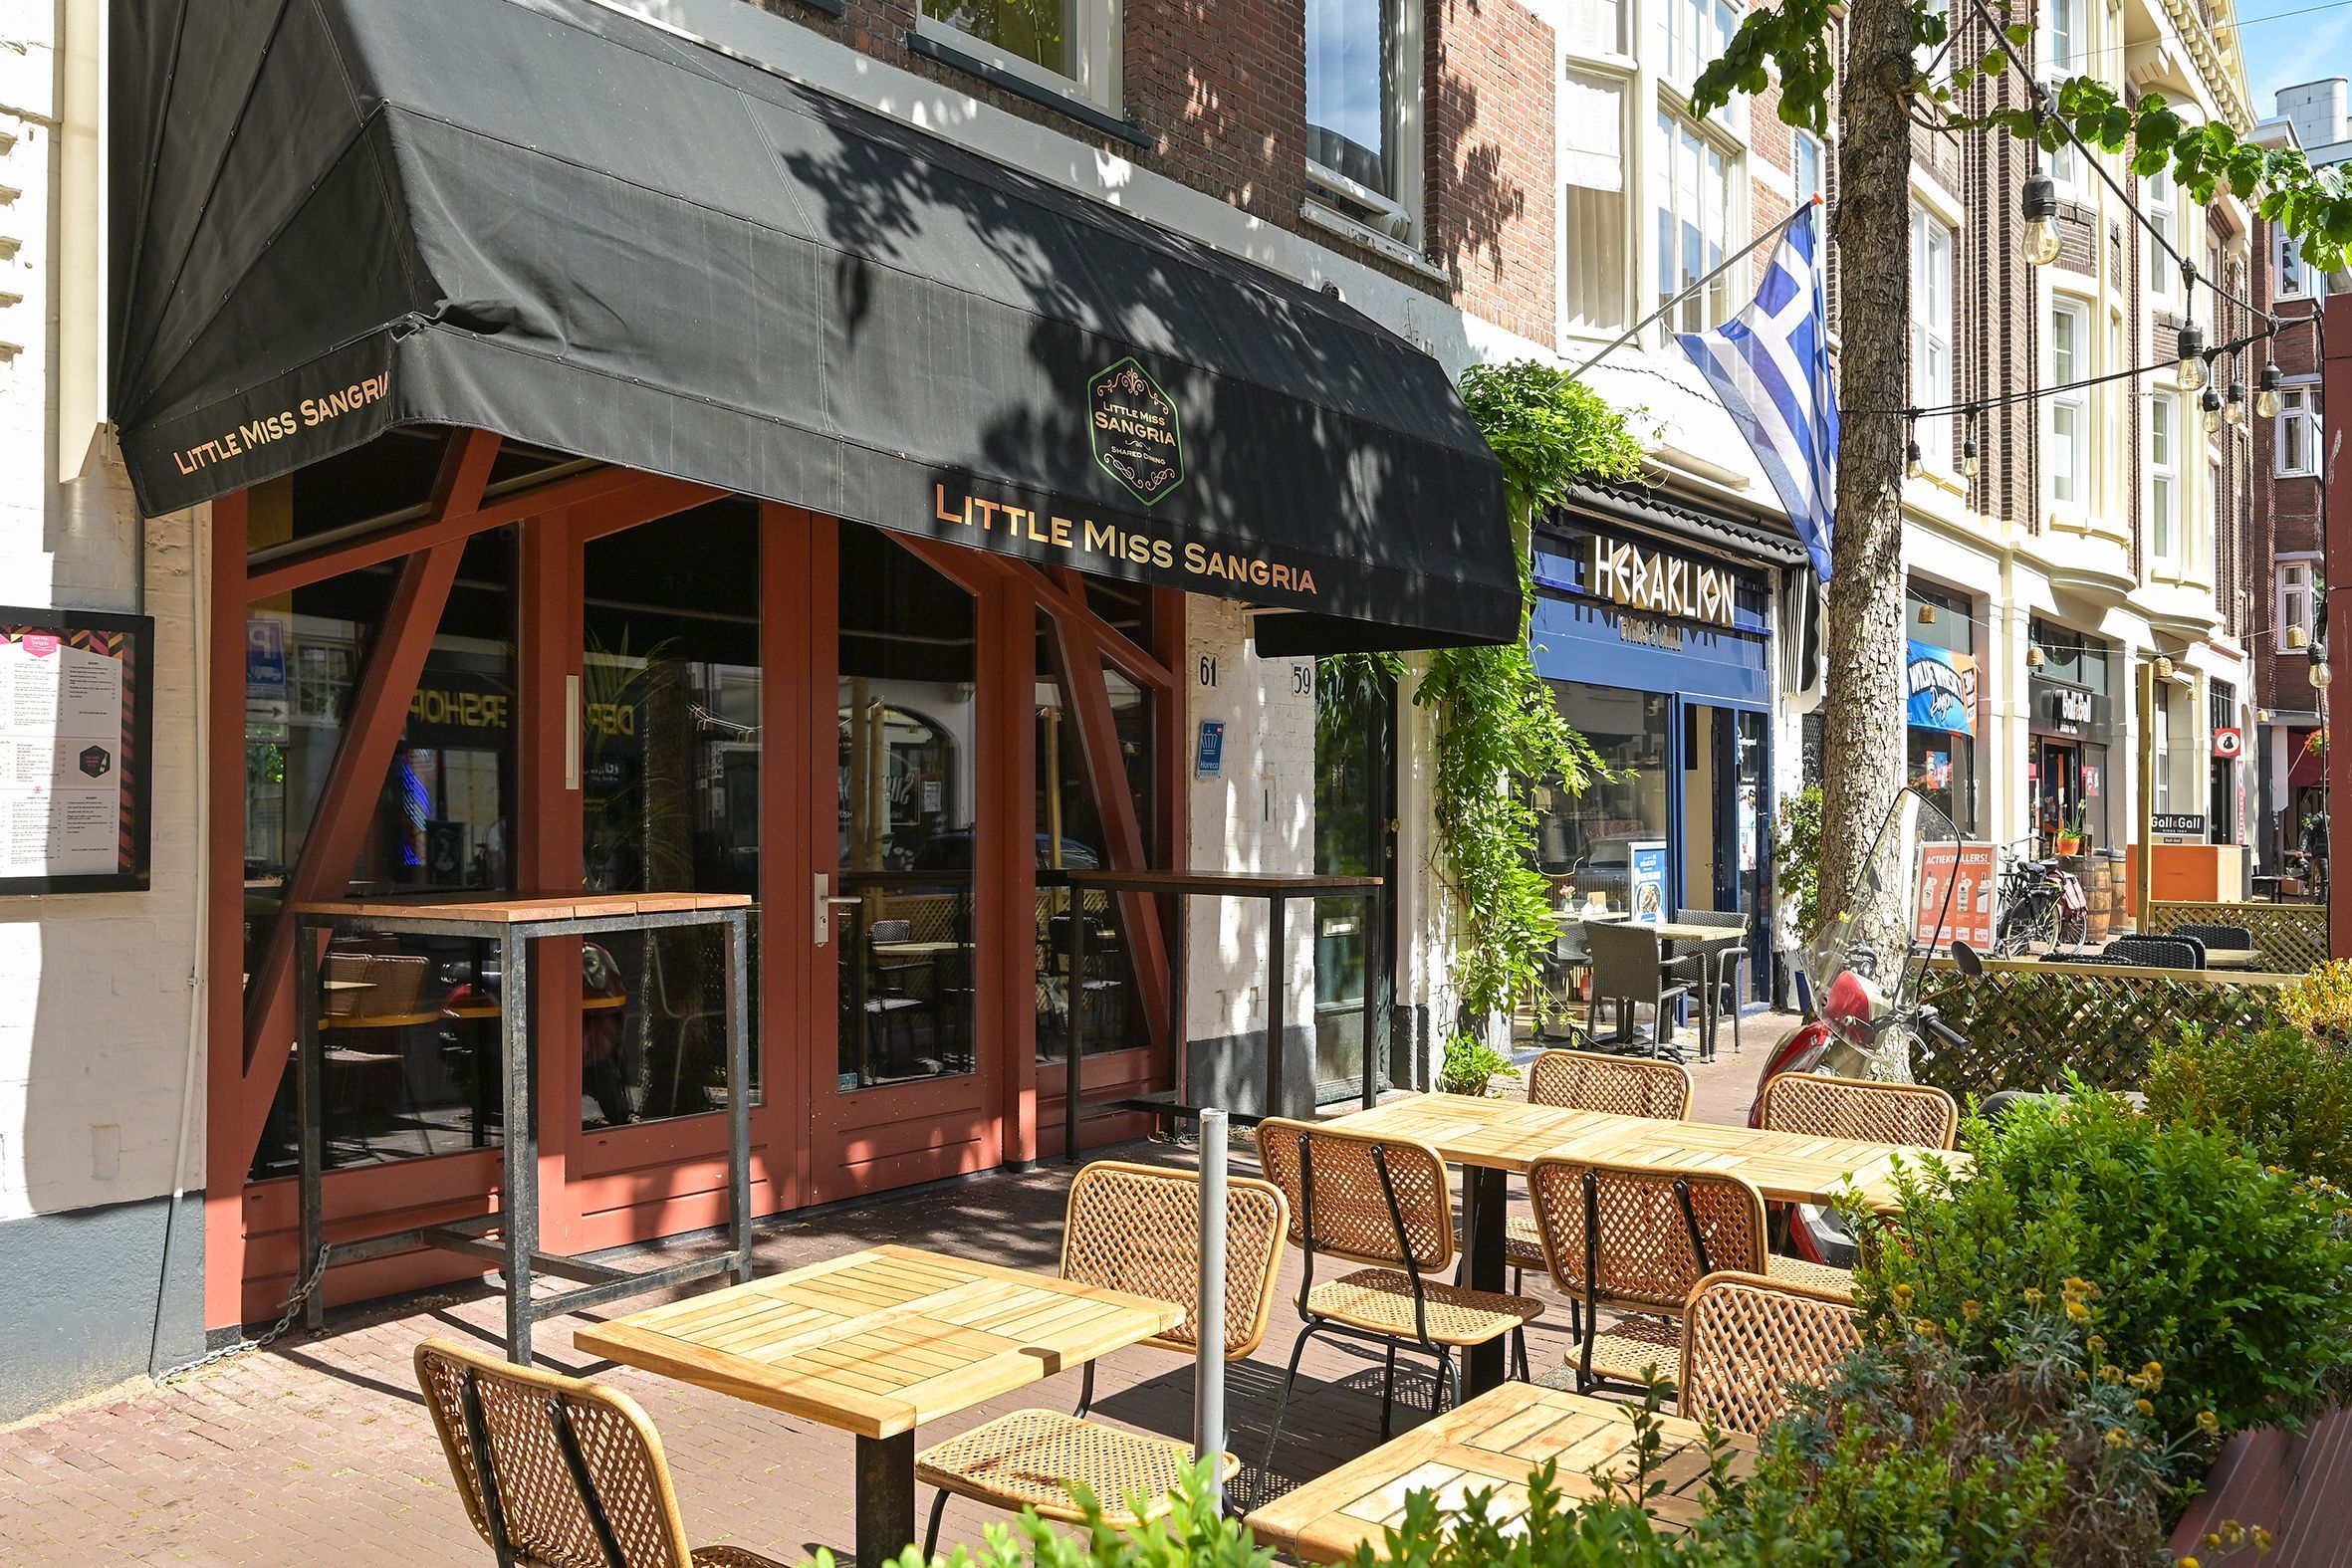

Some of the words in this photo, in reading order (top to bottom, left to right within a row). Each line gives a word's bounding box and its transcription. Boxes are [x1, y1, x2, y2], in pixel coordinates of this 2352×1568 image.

[1102, 400, 1139, 418] LITTLE
[1139, 410, 1166, 426] MISS
[173, 433, 242, 475] LITTLE
[239, 410, 298, 450] MISS
[1094, 410, 1177, 447] SANGRIA
[1110, 445, 1143, 459] SHARED
[1143, 452, 1166, 466] DINING
[935, 483, 1074, 550] LITTLE
[1083, 519, 1174, 570] MISS
[1183, 542, 1317, 595] SANGRIA
[1594, 534, 1736, 628] HERAKLION
[1200, 655, 1218, 687] 61
[1294, 666, 1311, 695] 59
[1199, 760, 1220, 770] Horeca
[1926, 853, 1988, 865] ACTIEKNLLERS!
